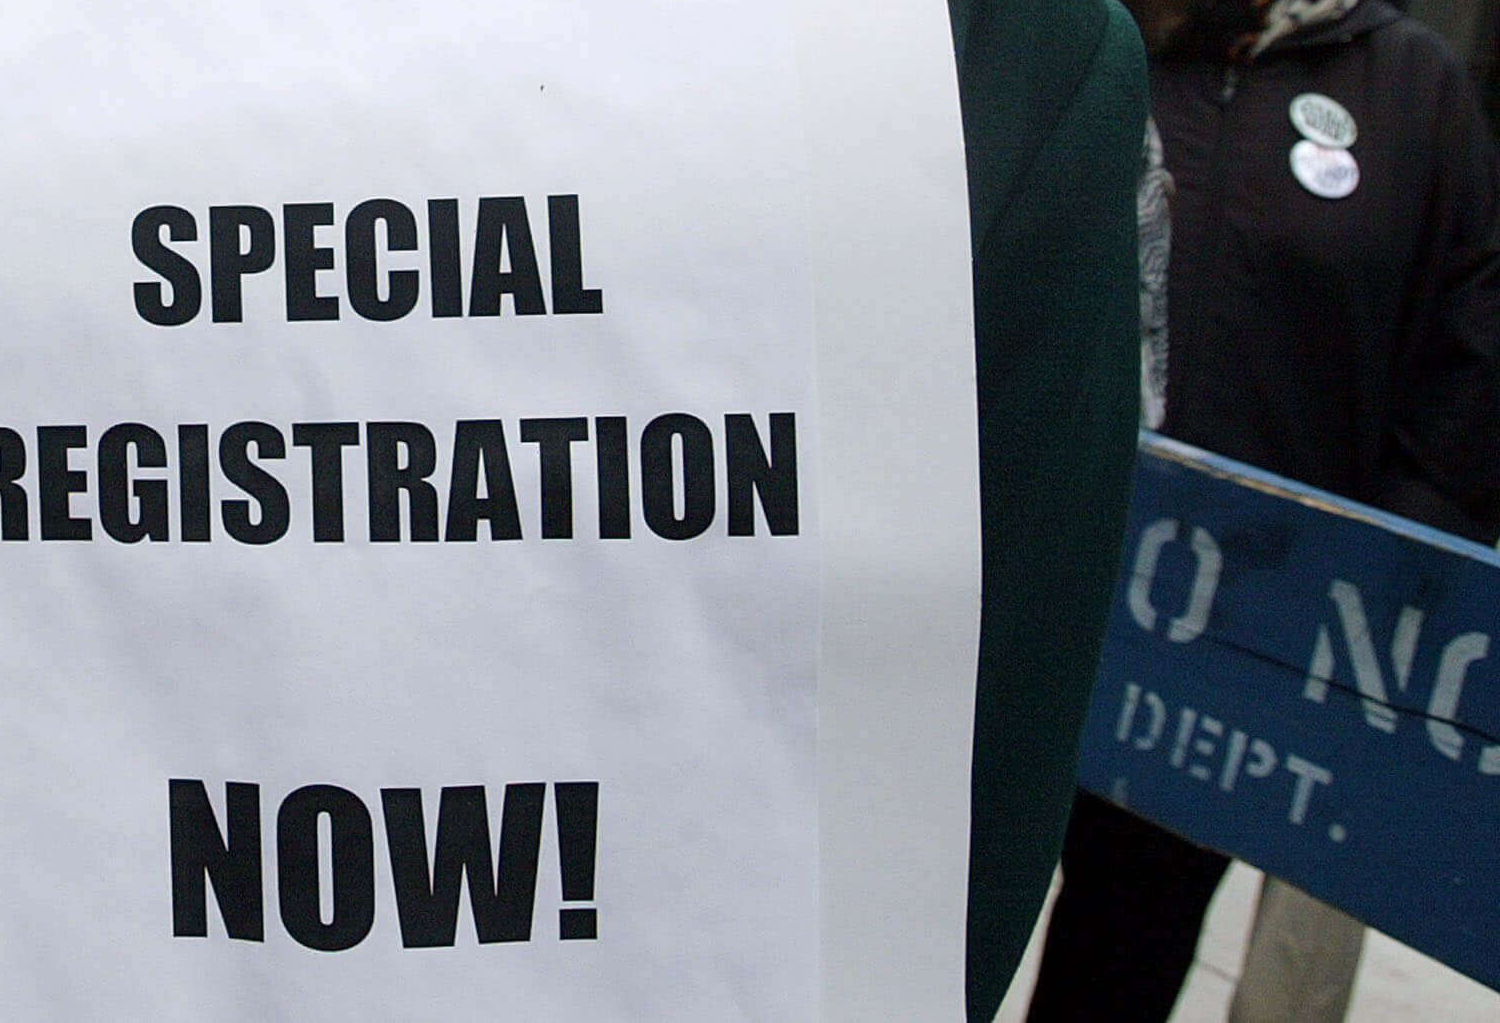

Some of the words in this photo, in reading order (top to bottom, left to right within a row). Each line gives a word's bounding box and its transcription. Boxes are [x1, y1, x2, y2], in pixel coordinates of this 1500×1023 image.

[130, 192, 605, 328] SPECIAL
[1115, 681, 1348, 844] DEPT.
[167, 777, 601, 954] NOW!
